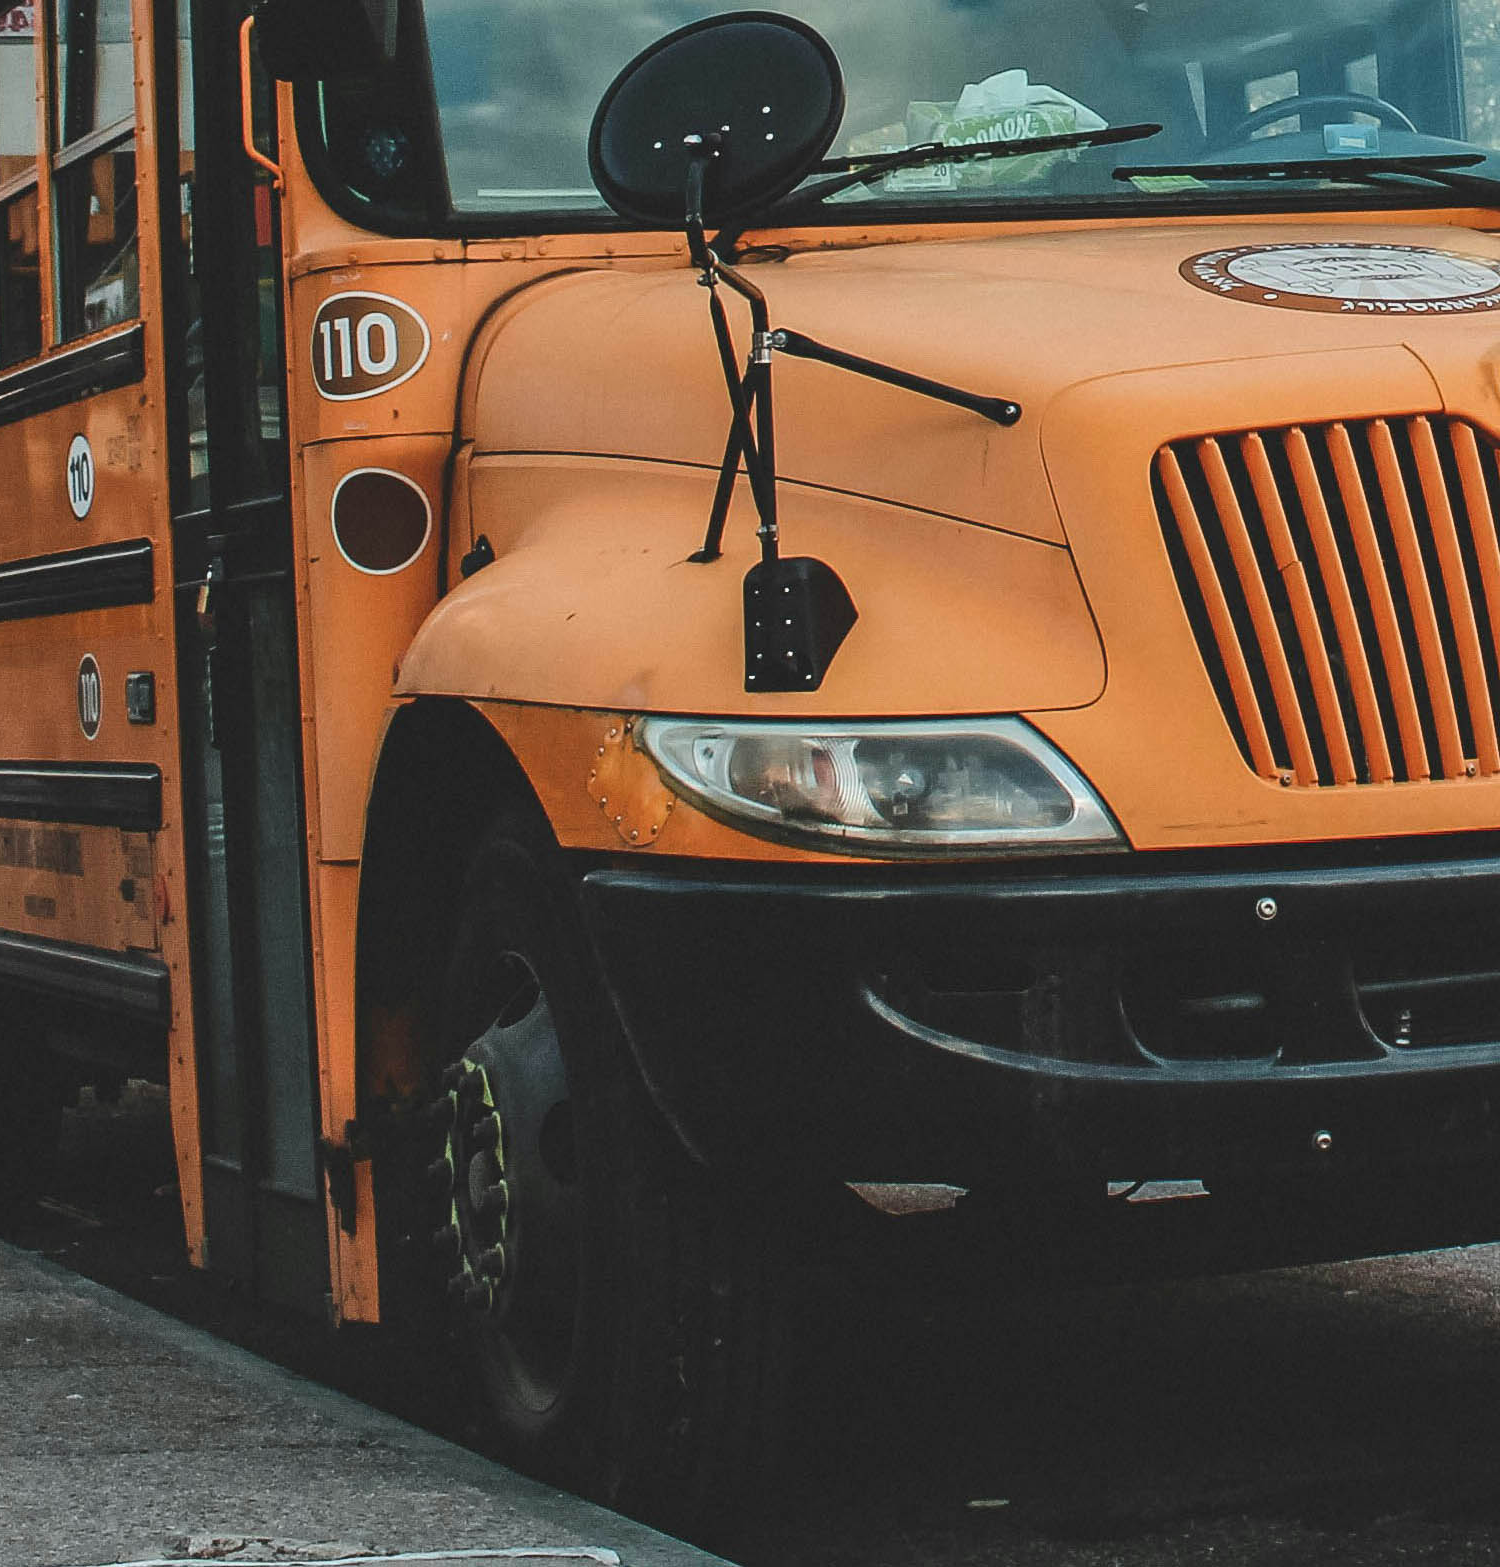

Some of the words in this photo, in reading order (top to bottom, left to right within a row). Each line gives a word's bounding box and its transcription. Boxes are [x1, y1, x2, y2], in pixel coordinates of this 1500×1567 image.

[319, 312, 398, 381] 110
[69, 451, 91, 504] 110
[81, 672, 99, 723] 110
